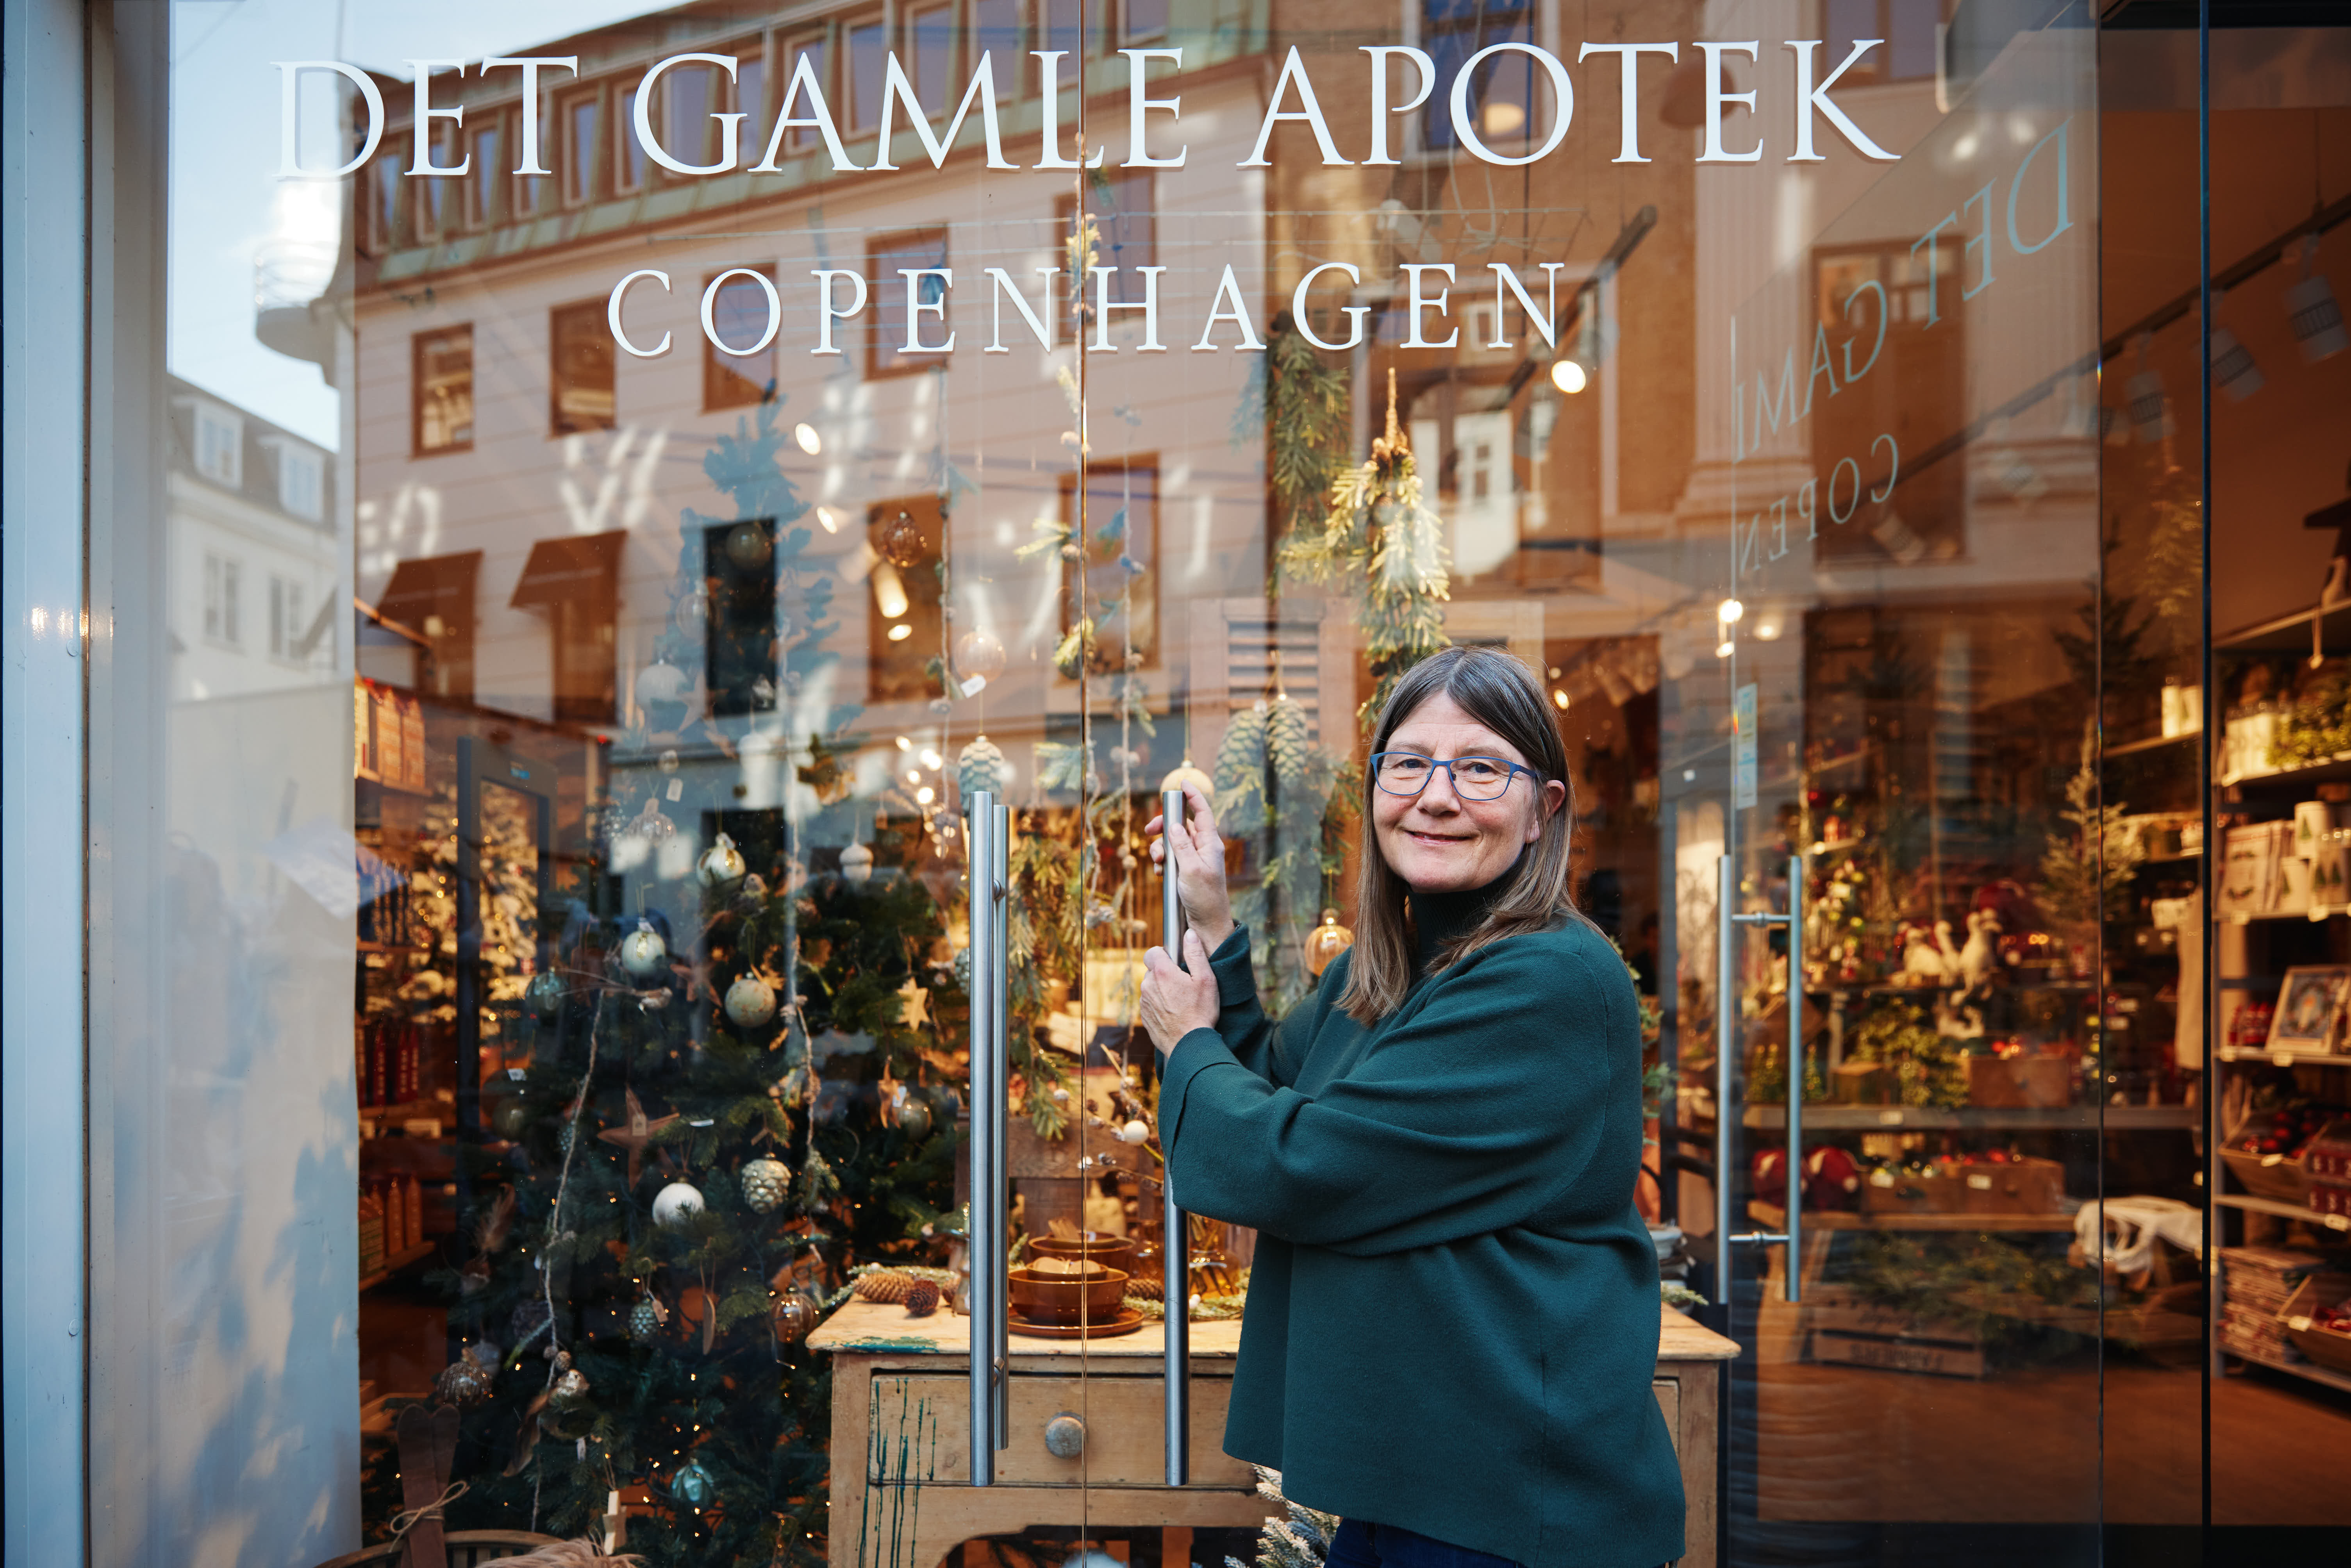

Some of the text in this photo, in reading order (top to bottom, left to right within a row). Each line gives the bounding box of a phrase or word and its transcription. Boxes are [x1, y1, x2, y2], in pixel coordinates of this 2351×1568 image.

[270, 39, 1901, 180] DET GAMLE APOTEK
[608, 260, 1565, 357] COPENHAGEN
